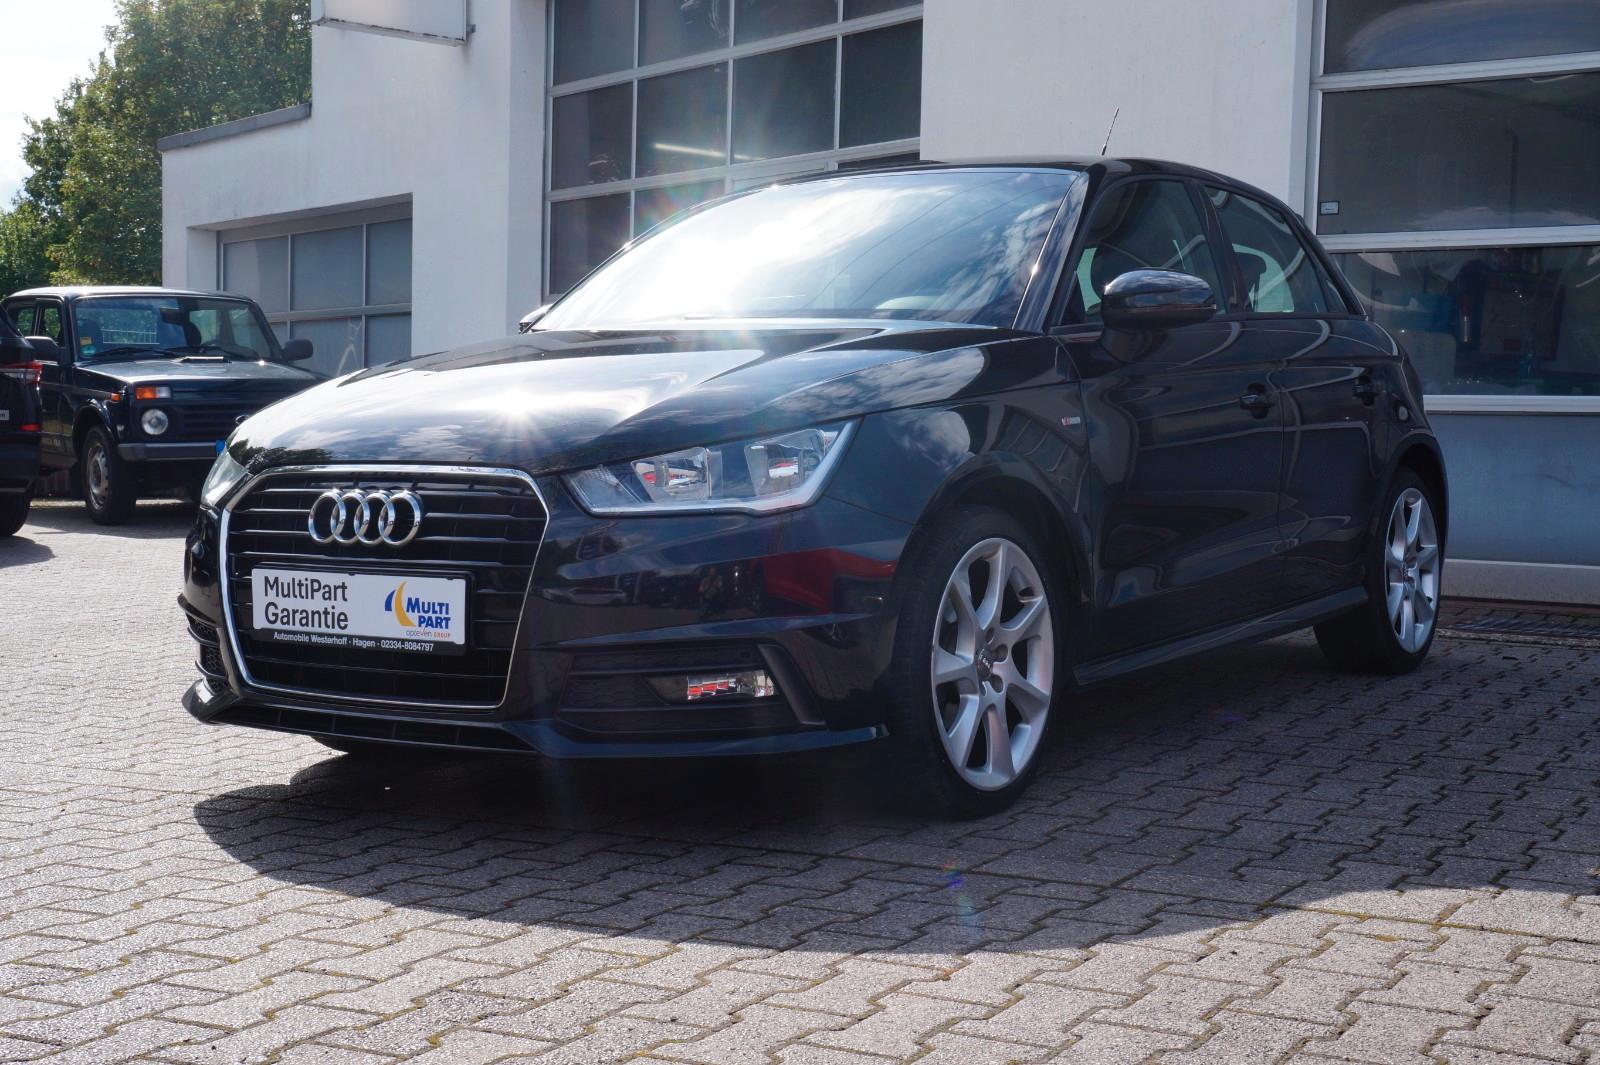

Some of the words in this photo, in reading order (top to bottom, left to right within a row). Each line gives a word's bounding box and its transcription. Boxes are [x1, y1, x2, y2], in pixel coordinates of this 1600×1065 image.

[264, 576, 348, 602] MultiPart
[264, 601, 349, 630] Garantie
[406, 597, 450, 616] MULTI
[418, 615, 451, 629] PART
[273, 631, 310, 643] Automobile
[310, 634, 348, 646] Westerhoff
[352, 637, 376, 648] Hagen
[380, 639, 434, 652] 02334-8084797
